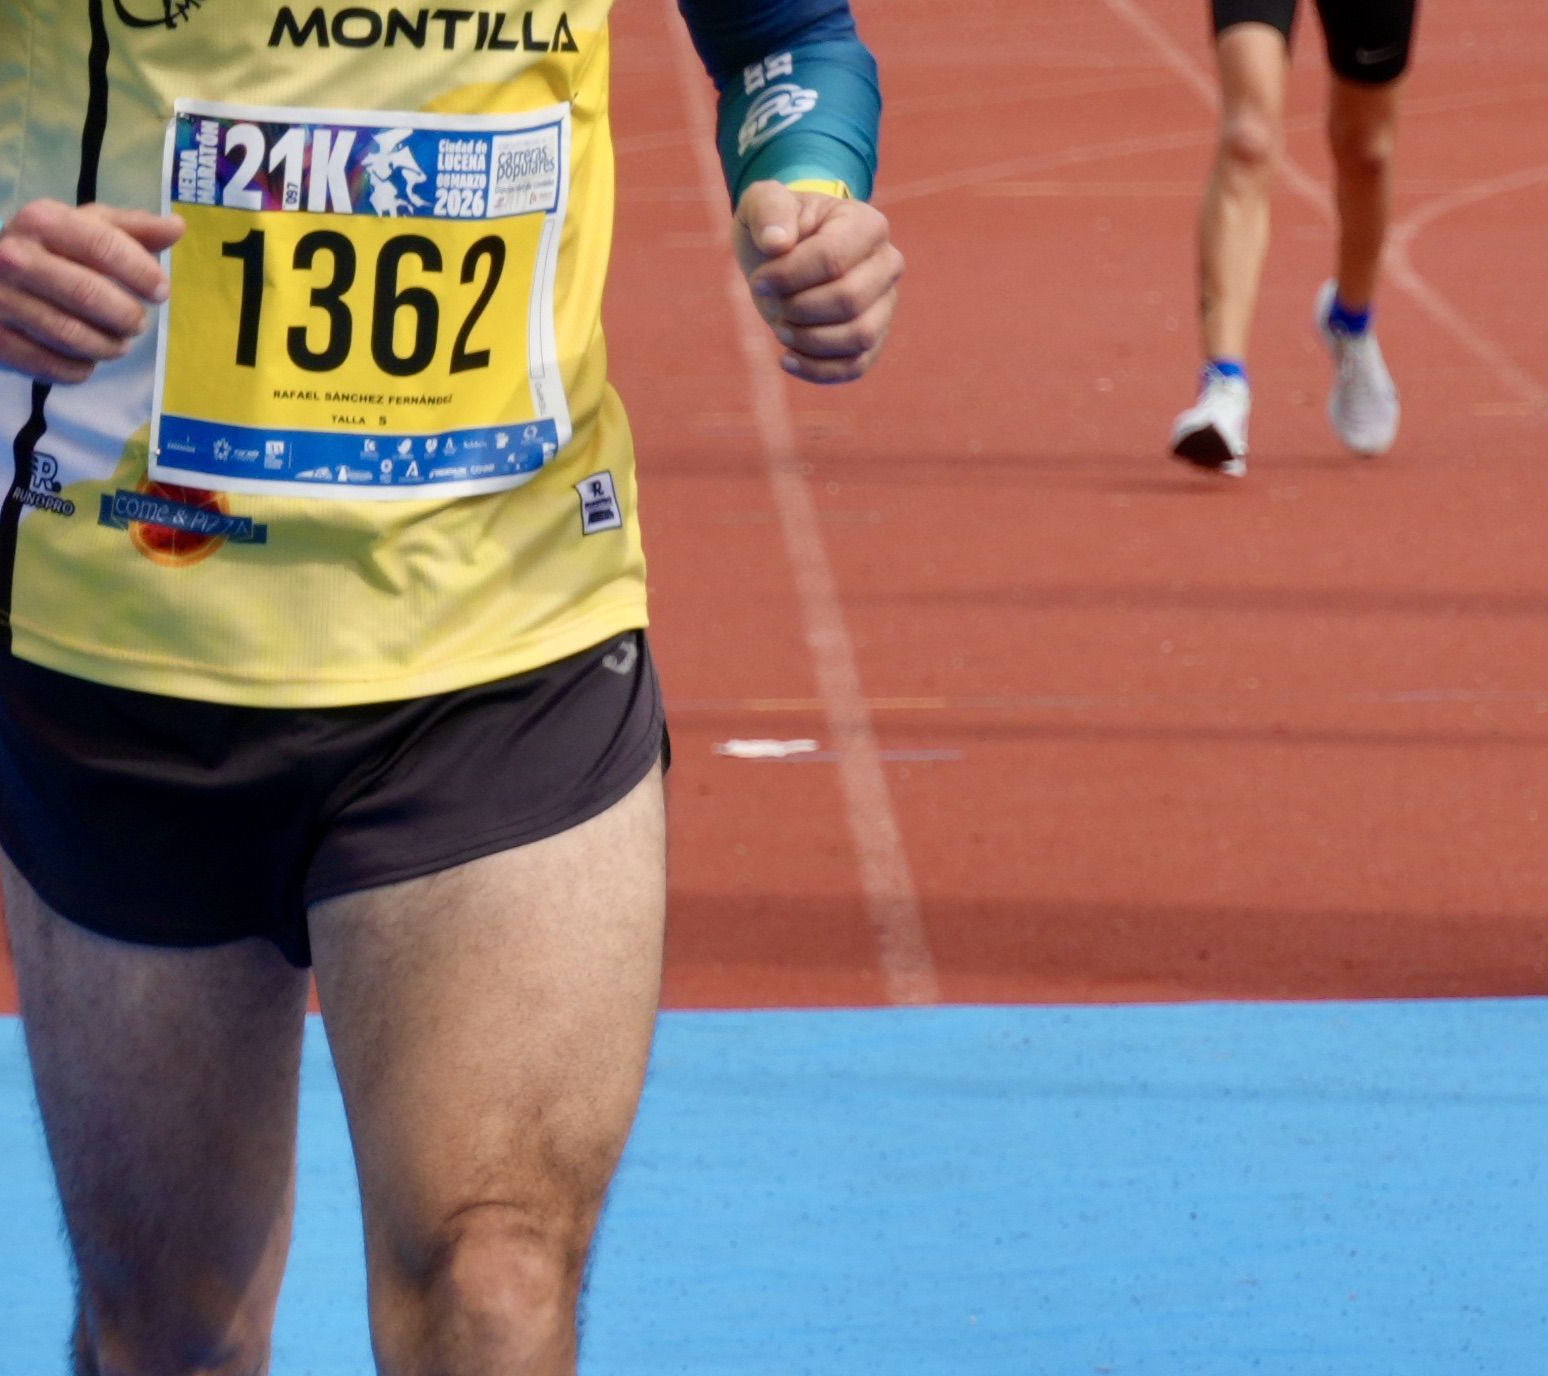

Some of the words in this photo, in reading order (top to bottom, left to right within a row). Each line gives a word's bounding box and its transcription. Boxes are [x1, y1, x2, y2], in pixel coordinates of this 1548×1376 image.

[267, 6, 580, 53] MONTILLA
[222, 123, 358, 214] 21K
[437, 152, 486, 172] LUCENA
[497, 145, 548, 167] carreras
[496, 156, 556, 185] populares
[433, 188, 485, 217] 2026
[221, 228, 507, 377] 1362
[273, 389, 320, 401] RAFAEL
[324, 390, 385, 405] SÁNCHEZ
[331, 414, 366, 425] TALLA
[171, 508, 189, 526] &
